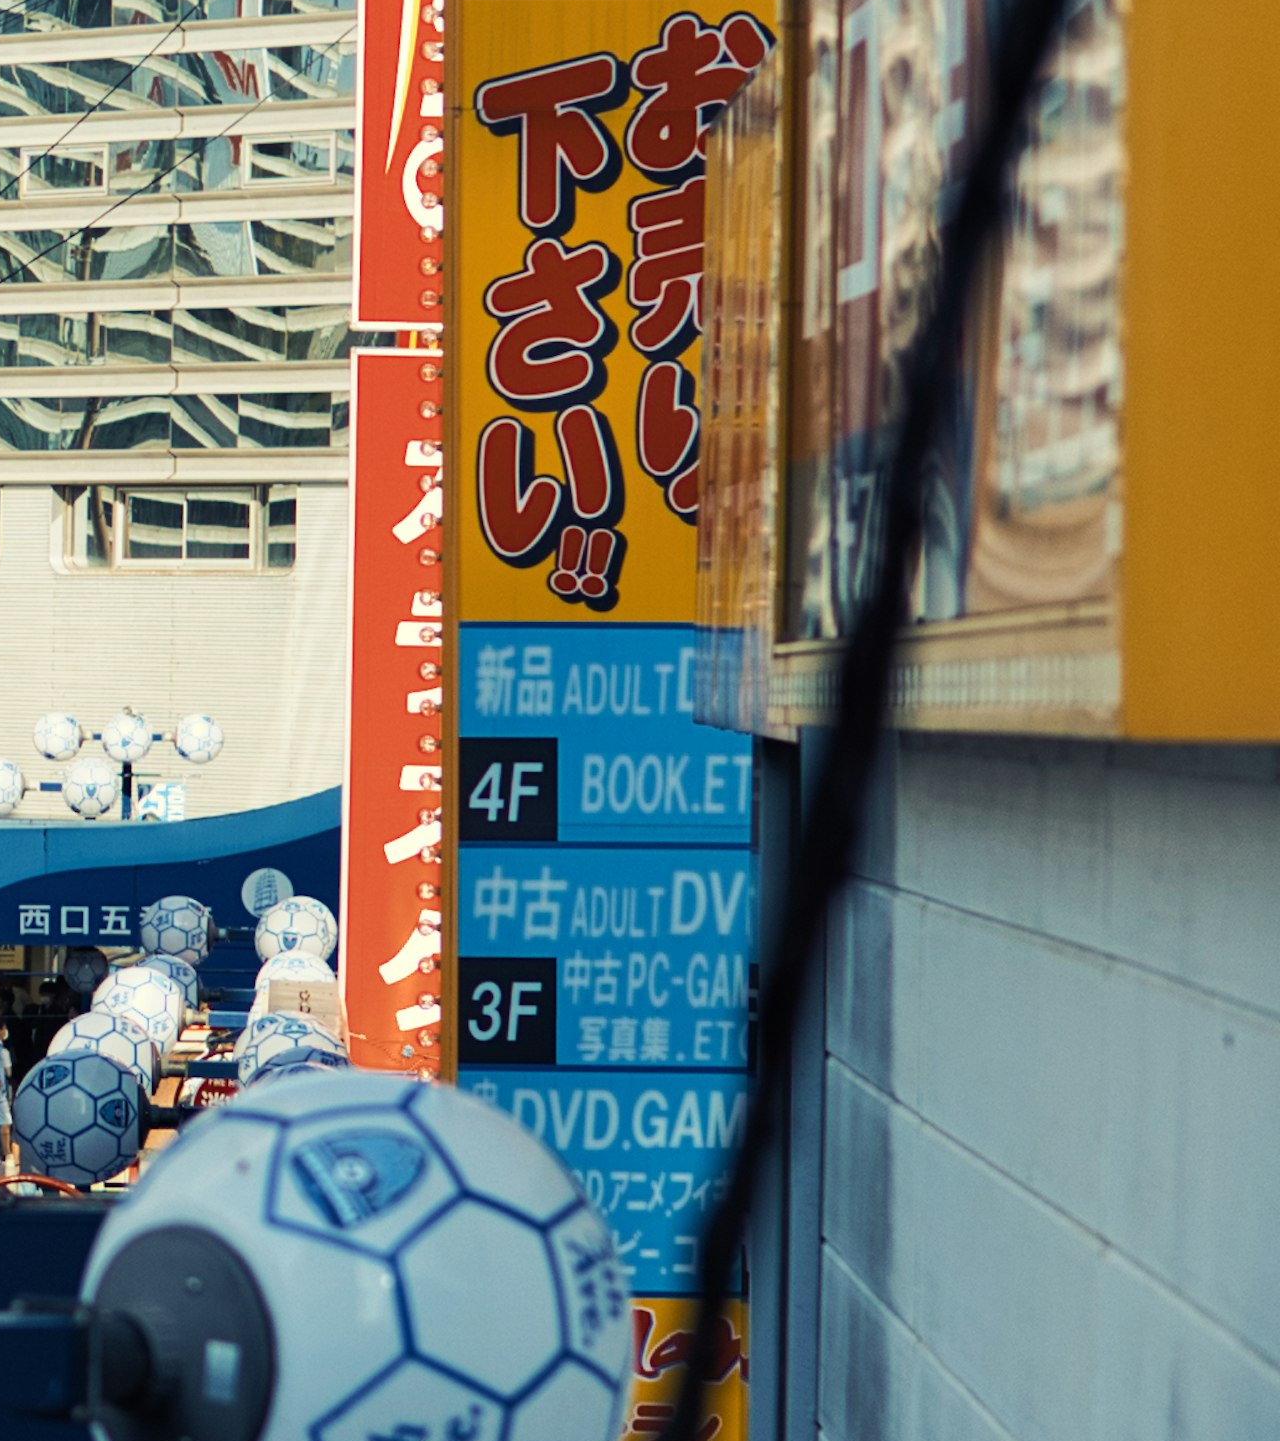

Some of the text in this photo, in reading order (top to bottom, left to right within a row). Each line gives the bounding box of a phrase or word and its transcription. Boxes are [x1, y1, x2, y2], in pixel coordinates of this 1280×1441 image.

[475, 645, 554, 717] 新品
[562, 664, 675, 716] ADULT
[468, 761, 544, 823] 4F
[472, 866, 752, 941] 中古 ADULT DV
[563, 951, 624, 1007] 中古
[468, 981, 543, 1042] 3F
